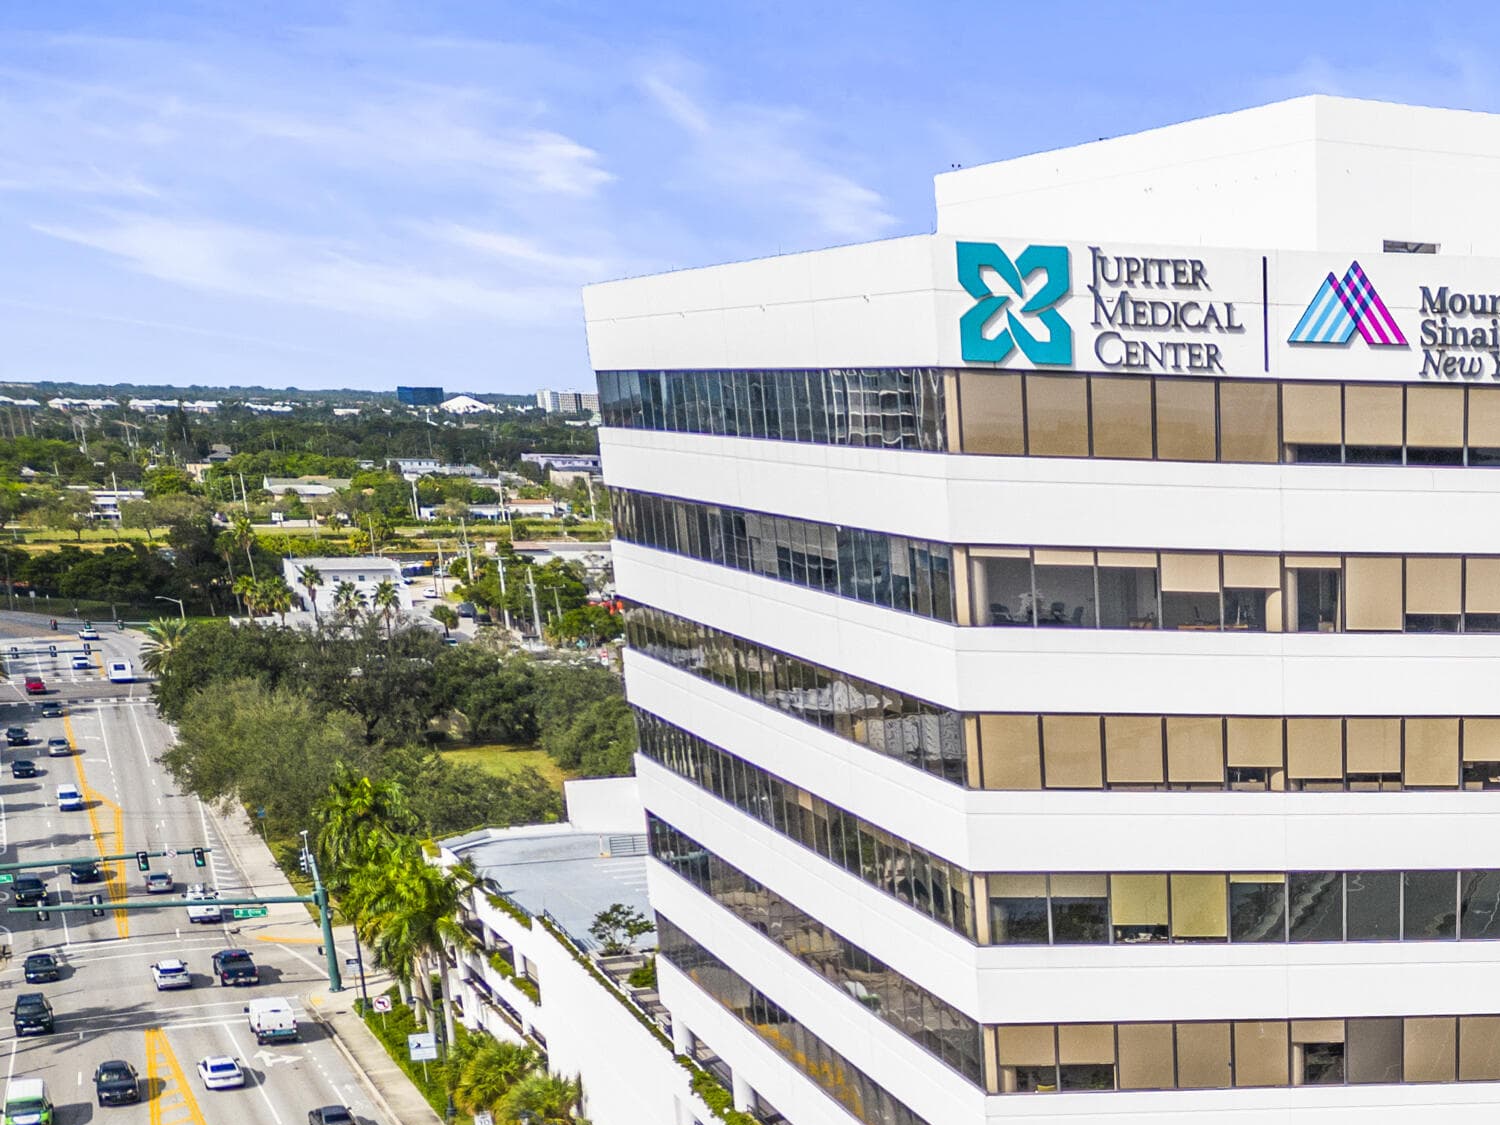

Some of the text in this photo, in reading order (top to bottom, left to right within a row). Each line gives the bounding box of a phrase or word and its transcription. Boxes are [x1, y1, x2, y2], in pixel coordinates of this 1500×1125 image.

[1088, 245, 1211, 290] JUPITER
[1087, 284, 1245, 330] MEDICAL
[1094, 331, 1225, 372] CENTER
[1420, 317, 1500, 348] Sinai
[1418, 349, 1483, 376] New
